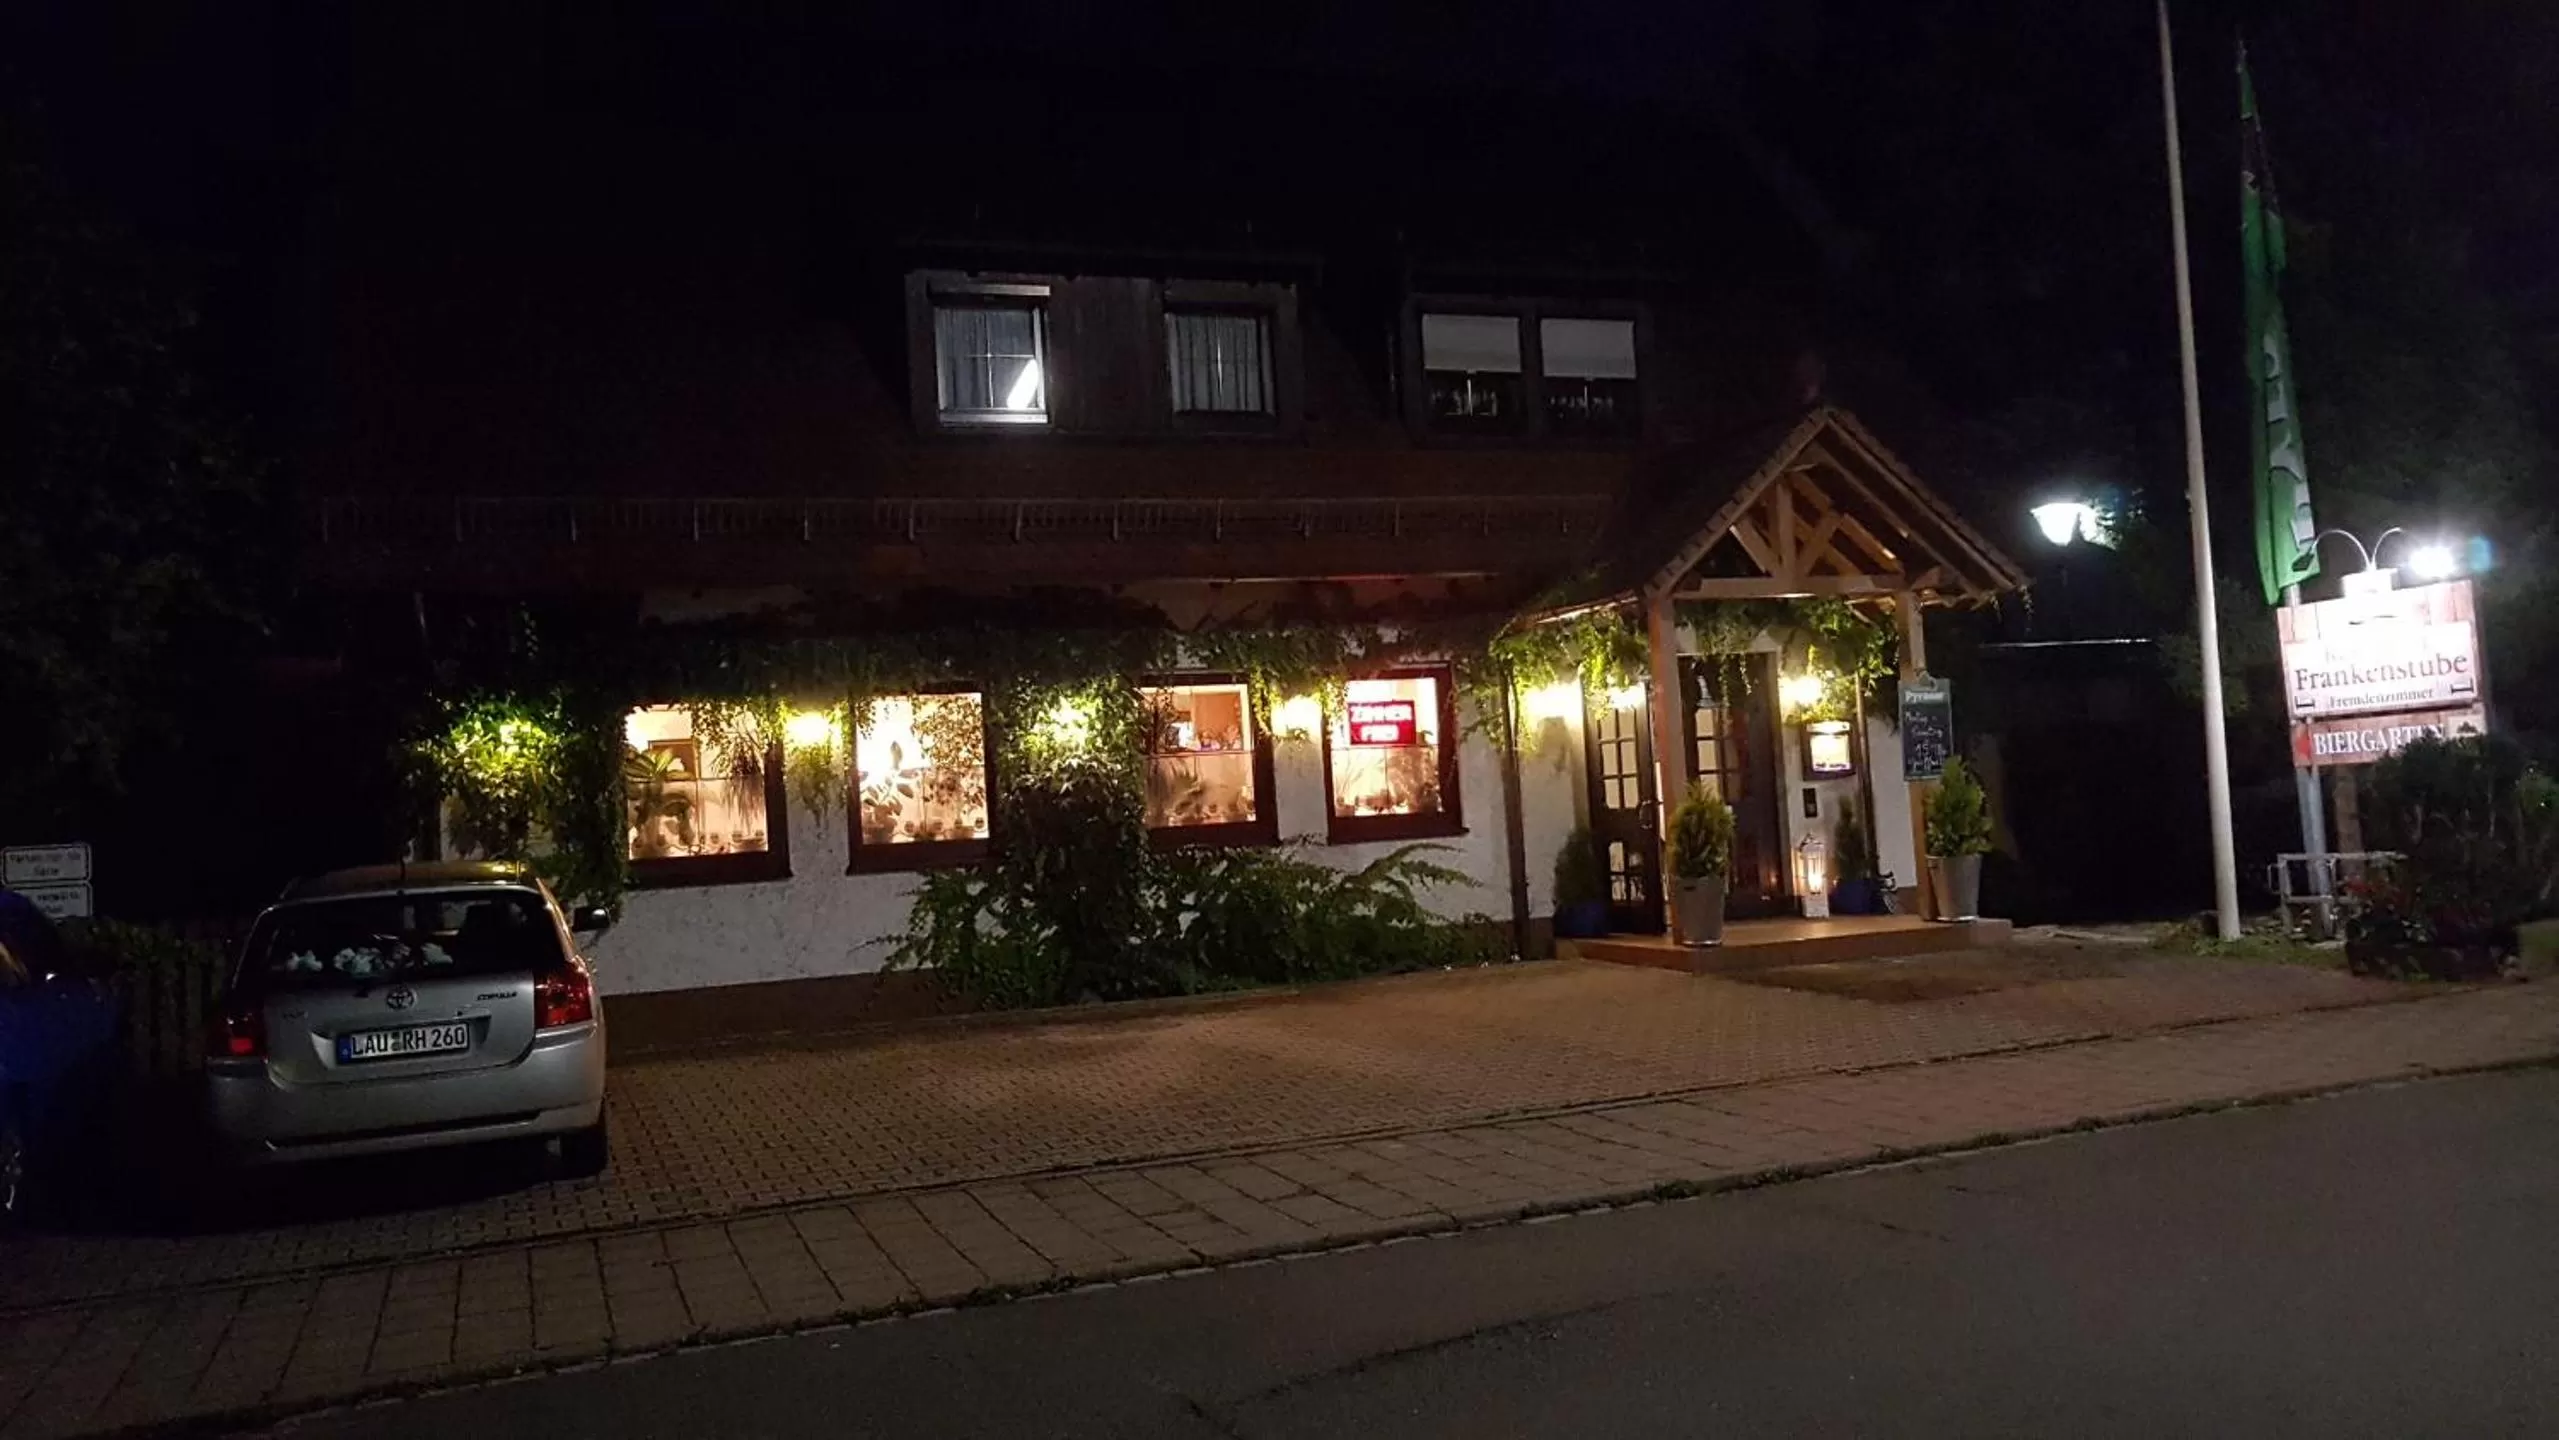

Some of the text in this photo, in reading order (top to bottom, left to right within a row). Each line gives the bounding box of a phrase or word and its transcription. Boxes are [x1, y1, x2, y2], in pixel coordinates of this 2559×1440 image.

[2295, 653, 2468, 691] Frankenstube
[2330, 687, 2434, 709] Fremdenzimmer
[352, 1027, 465, 1055] LAU RH 260
